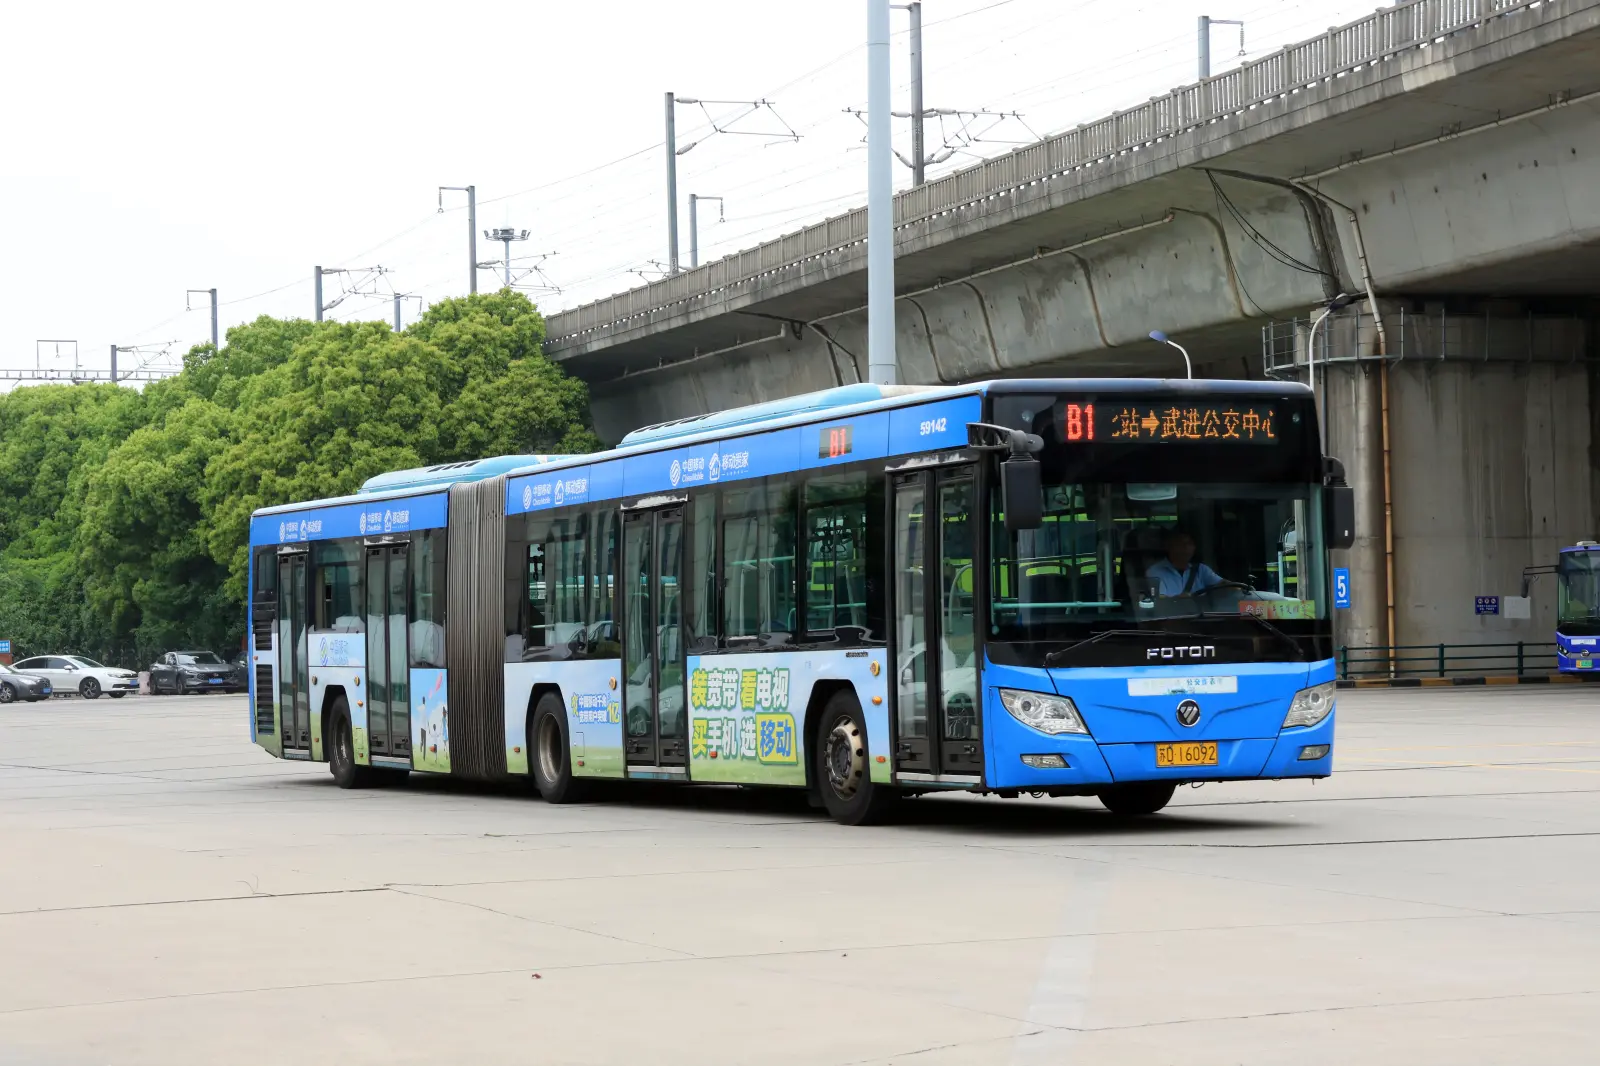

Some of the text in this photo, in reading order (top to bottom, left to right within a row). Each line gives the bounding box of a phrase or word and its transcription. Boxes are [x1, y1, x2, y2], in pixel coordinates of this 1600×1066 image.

[919, 417, 947, 436] 59142
[1067, 404, 1094, 440] B1
[1161, 407, 1275, 438] 武进公交中心
[682, 457, 704, 472] 中国移动
[1337, 575, 1347, 598] 5
[1146, 645, 1216, 660] FOTON
[692, 667, 790, 711] 装宽带 看电视
[692, 717, 737, 759] 买手机
